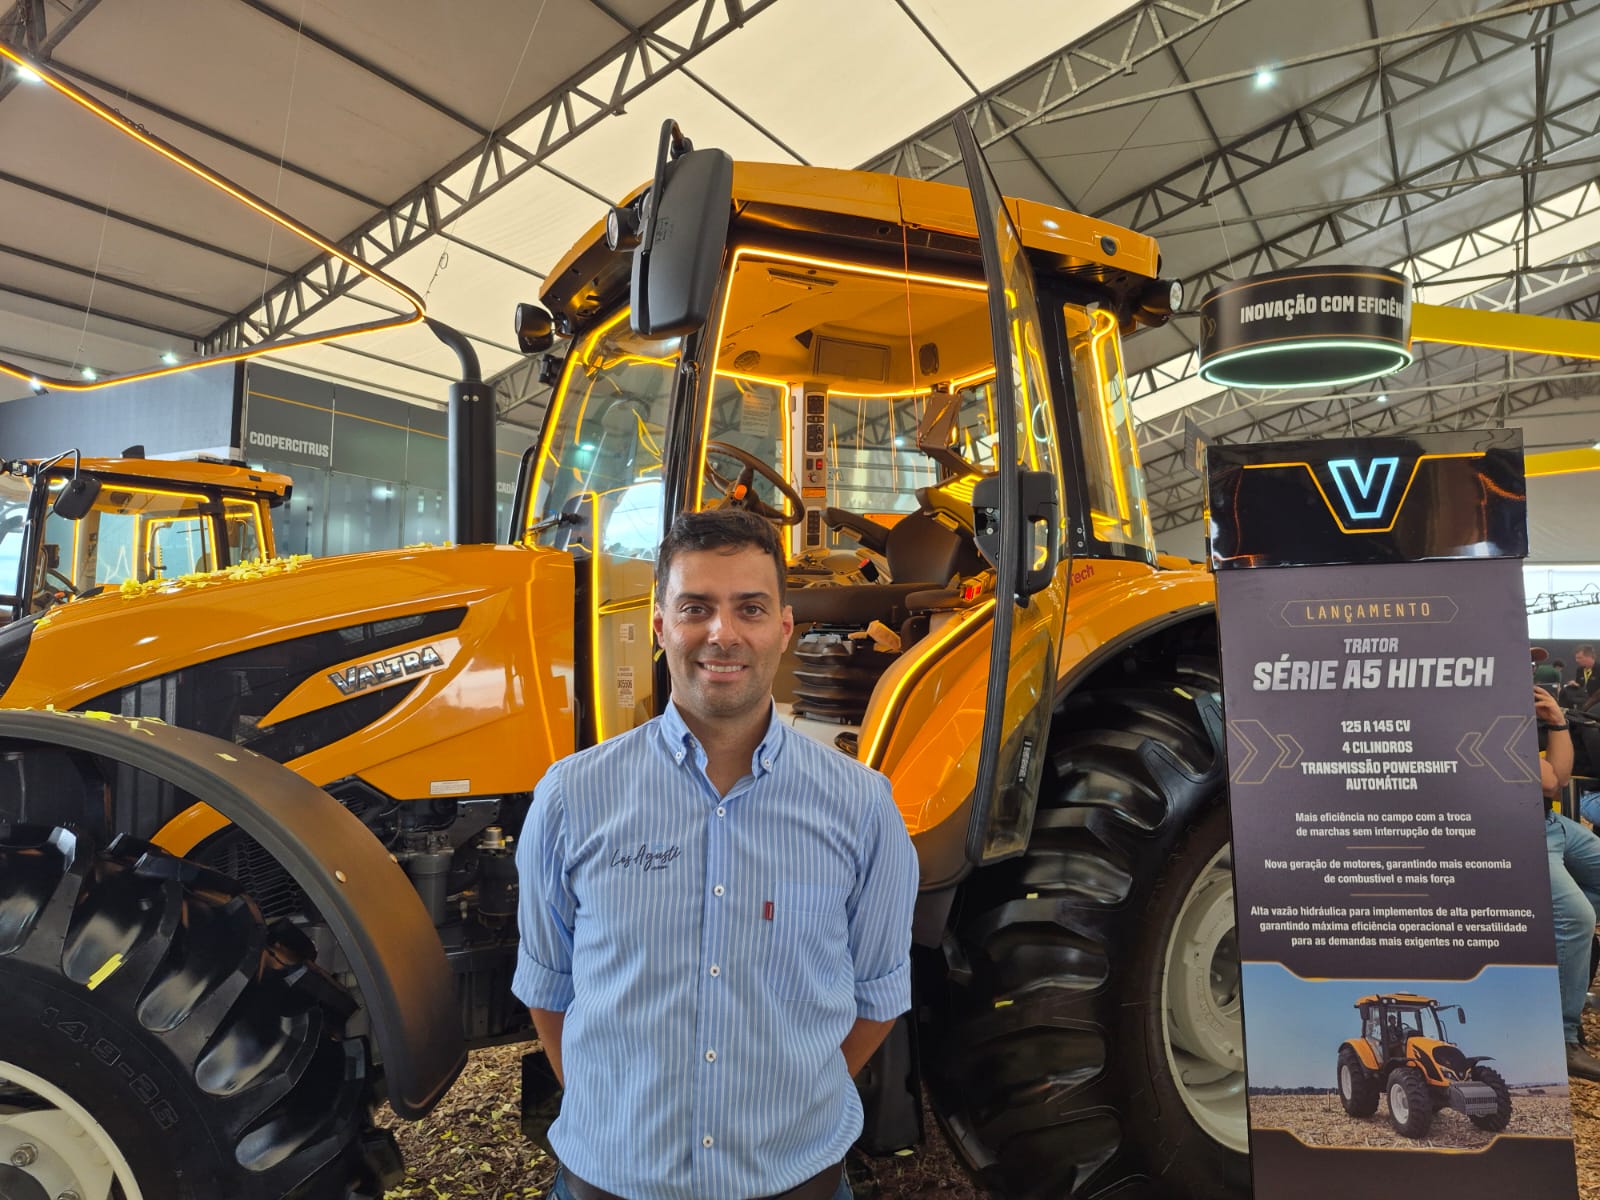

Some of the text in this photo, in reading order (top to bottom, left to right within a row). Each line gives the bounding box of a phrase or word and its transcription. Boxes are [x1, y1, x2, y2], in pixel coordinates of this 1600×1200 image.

[1240, 293, 1317, 324] INOVAÇÃO
[1321, 295, 1355, 313] COM
[249, 431, 329, 457] COOPERCITRUS
[1306, 602, 1431, 623] LANÇAMENTO
[1343, 637, 1399, 654] TRATOR
[327, 646, 445, 696] VALTRA
[1252, 654, 1495, 691] SÉRIE A5 HITECH
[1340, 720, 1411, 733] 125 A 145 CV
[1342, 741, 1413, 754] 4 CILINDROS
[1301, 759, 1458, 774] TRANSMISSÃO POWERSHIFT
[1346, 775, 1418, 790] AUTOMÁTICA
[1295, 811, 1472, 823] Mais eficiência no campo com a troca
[1296, 826, 1476, 838] de marchas sem interrupção de torque
[1264, 859, 1512, 871] Nova geração de motores, garantindo mais economia
[1324, 874, 1336, 883] de
[1396, 875, 1403, 883] e
[1405, 874, 1428, 883] mais
[1430, 874, 1455, 886] força
[1250, 906, 1535, 919] Alta vazão hidráulica para implementos de alta performance,
[1259, 921, 1528, 933] garantindo máxima eficiência operacional e versatilidade
[1291, 936, 1500, 949] para as demandas mais exigentes no campo
